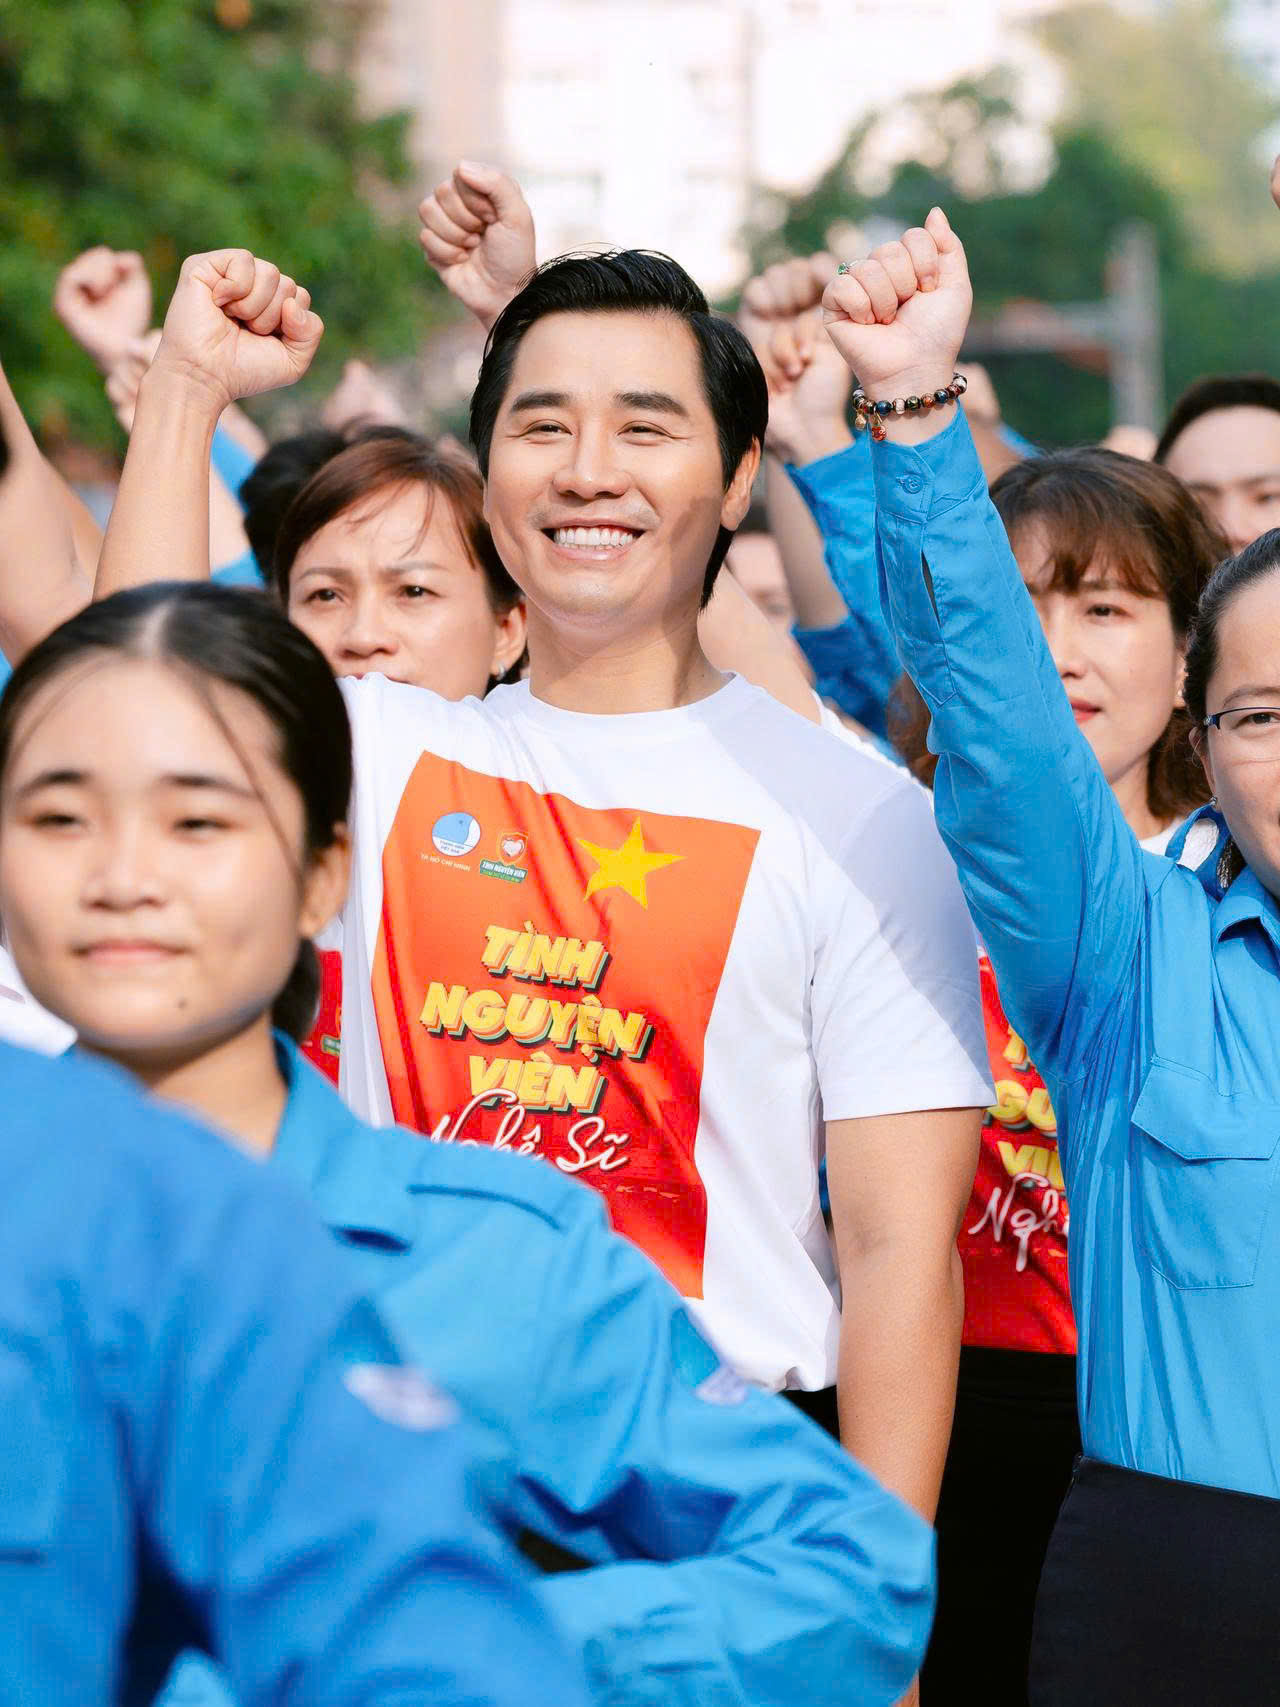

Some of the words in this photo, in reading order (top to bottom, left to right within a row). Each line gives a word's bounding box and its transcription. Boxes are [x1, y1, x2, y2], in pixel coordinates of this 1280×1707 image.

[481, 920, 612, 990] TÌNH
[419, 981, 653, 1063] NGUYỆN
[469, 1050, 608, 1114] VIÊN
[556, 1115, 629, 1173] Sĩ
